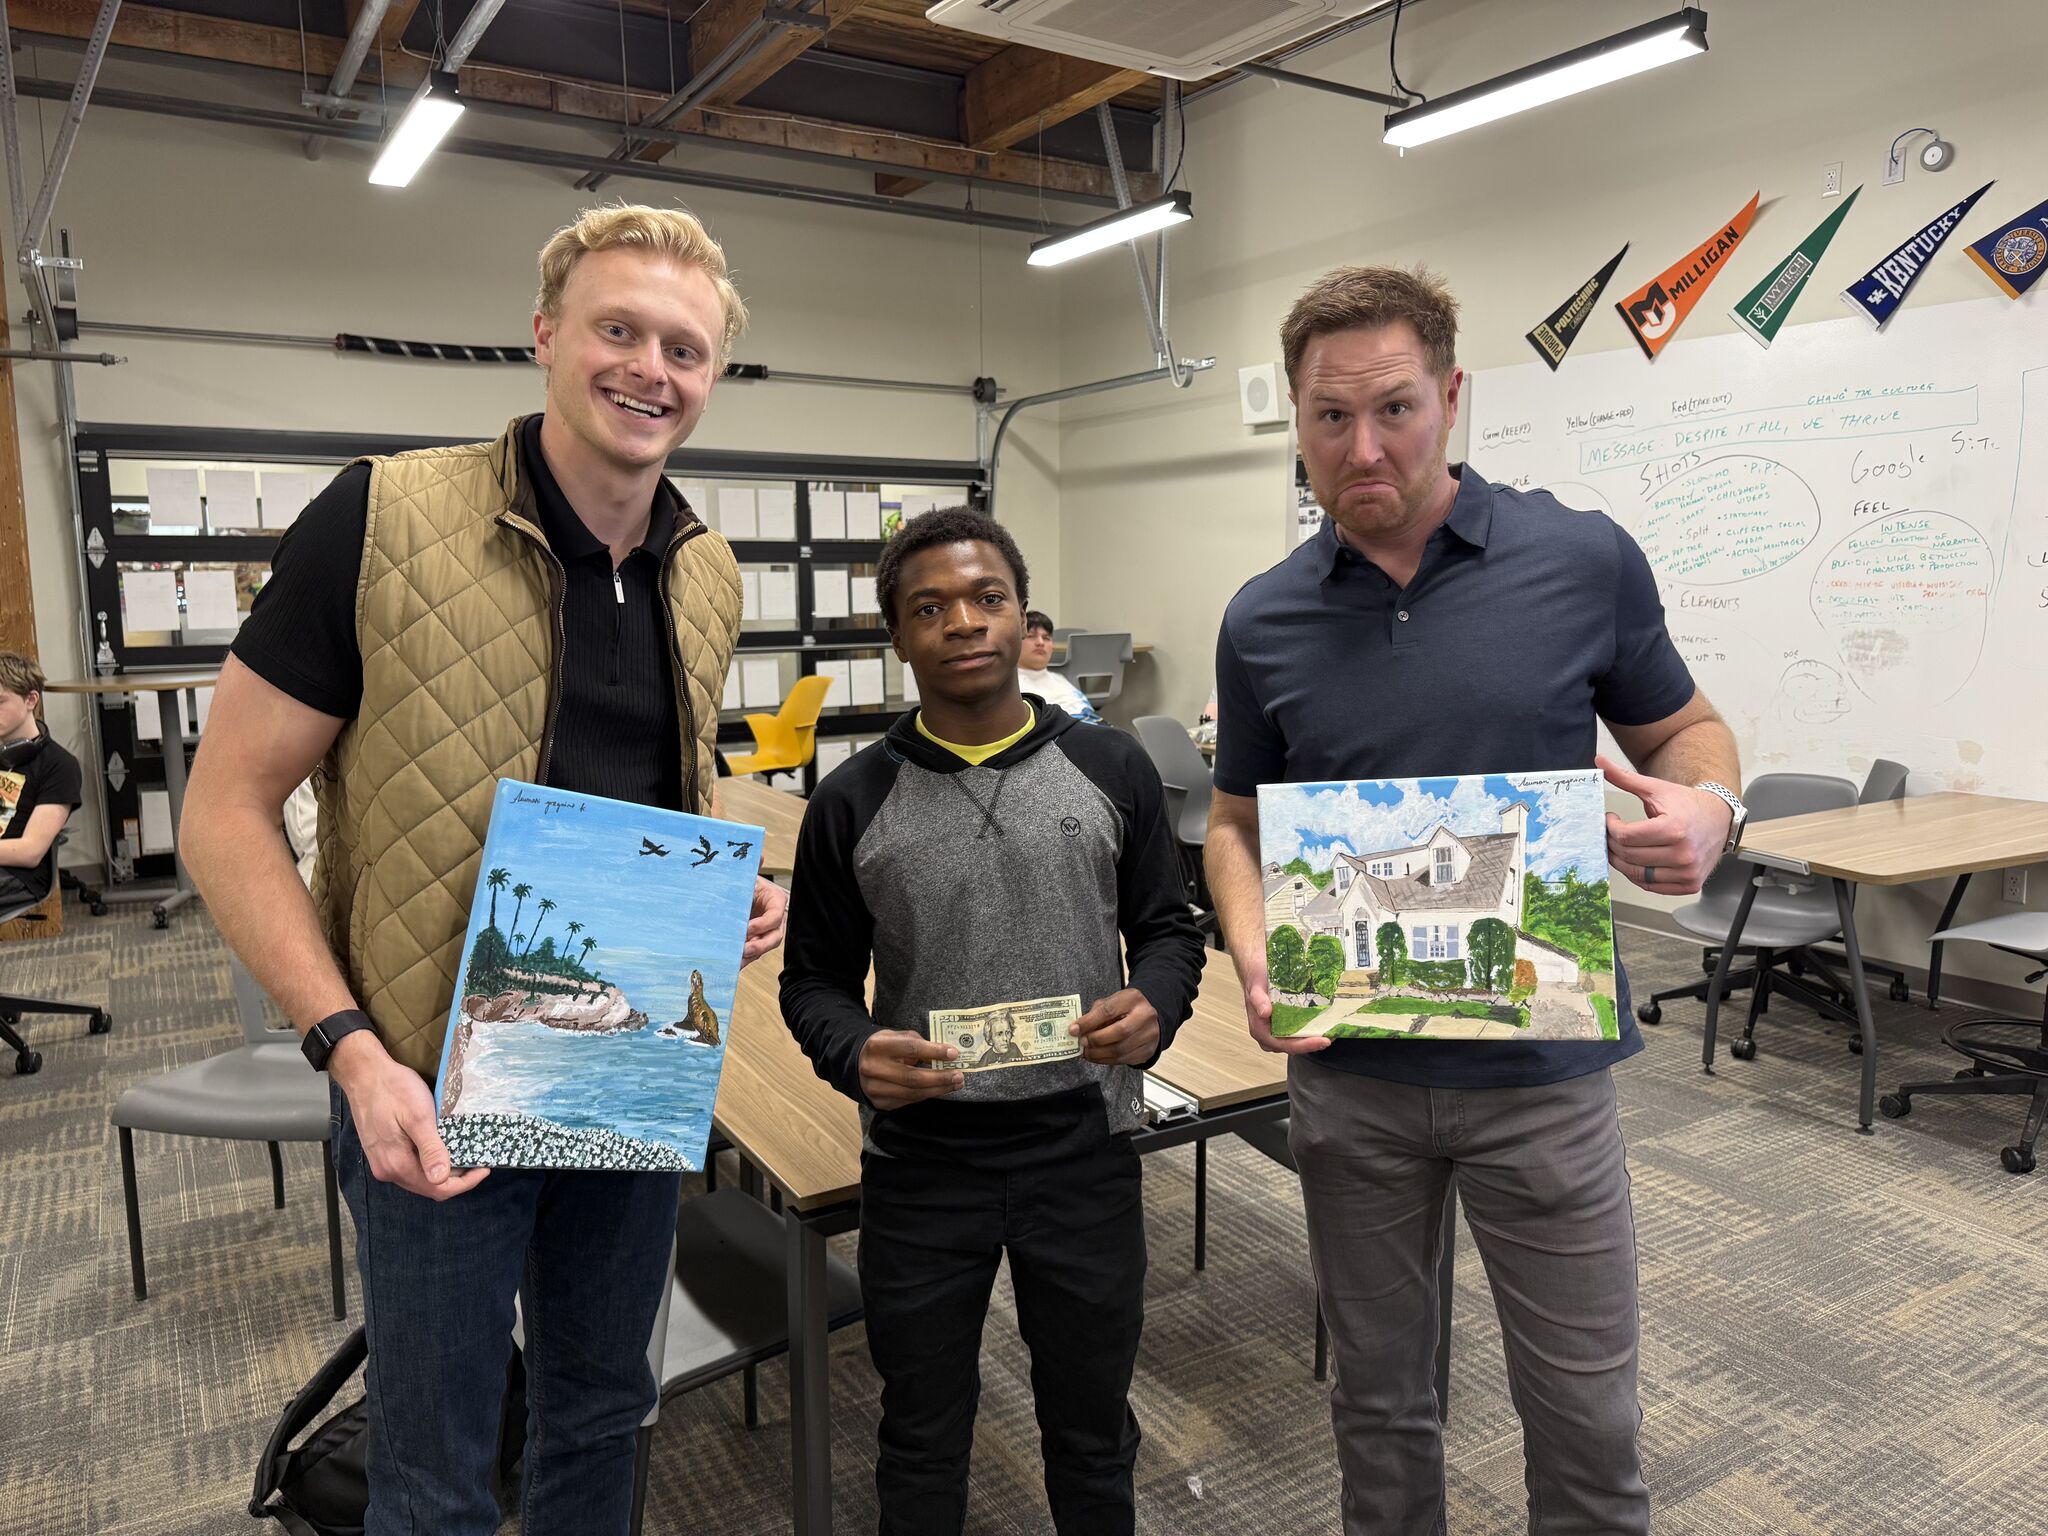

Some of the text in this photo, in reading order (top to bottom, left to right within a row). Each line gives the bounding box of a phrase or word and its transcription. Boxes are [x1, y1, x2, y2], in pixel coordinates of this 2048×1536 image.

[1871, 207, 1960, 299] KENTUCKY
[1668, 226, 1739, 300] MILLIGAN
[1765, 258, 1804, 304] IVY TECH
[1554, 278, 1599, 333] POLYTECHNIC
[1538, 326, 1562, 357] PURDUE
[1567, 416, 1588, 429] Yellow
[1675, 426, 1727, 447] DESPITE
[1738, 423, 1755, 436] IT
[1840, 411, 1901, 429] THRIVE
[1851, 443, 1925, 484] Google
[1640, 451, 1701, 495] SHOTS
[1716, 483, 1766, 501] CHILDHOOD
[1737, 491, 1770, 504] VIDEOS
[1854, 500, 1890, 516] FEEL
[1686, 524, 1709, 541] Split
[1881, 519, 1931, 532] INTENSE
[1735, 536, 1763, 546] MEDIA
[1848, 539, 1883, 550] FOLLOW
[1731, 547, 1760, 558] ACTION
[1680, 590, 1740, 610] ELEMENTS
[1715, 653, 1726, 661] TO
